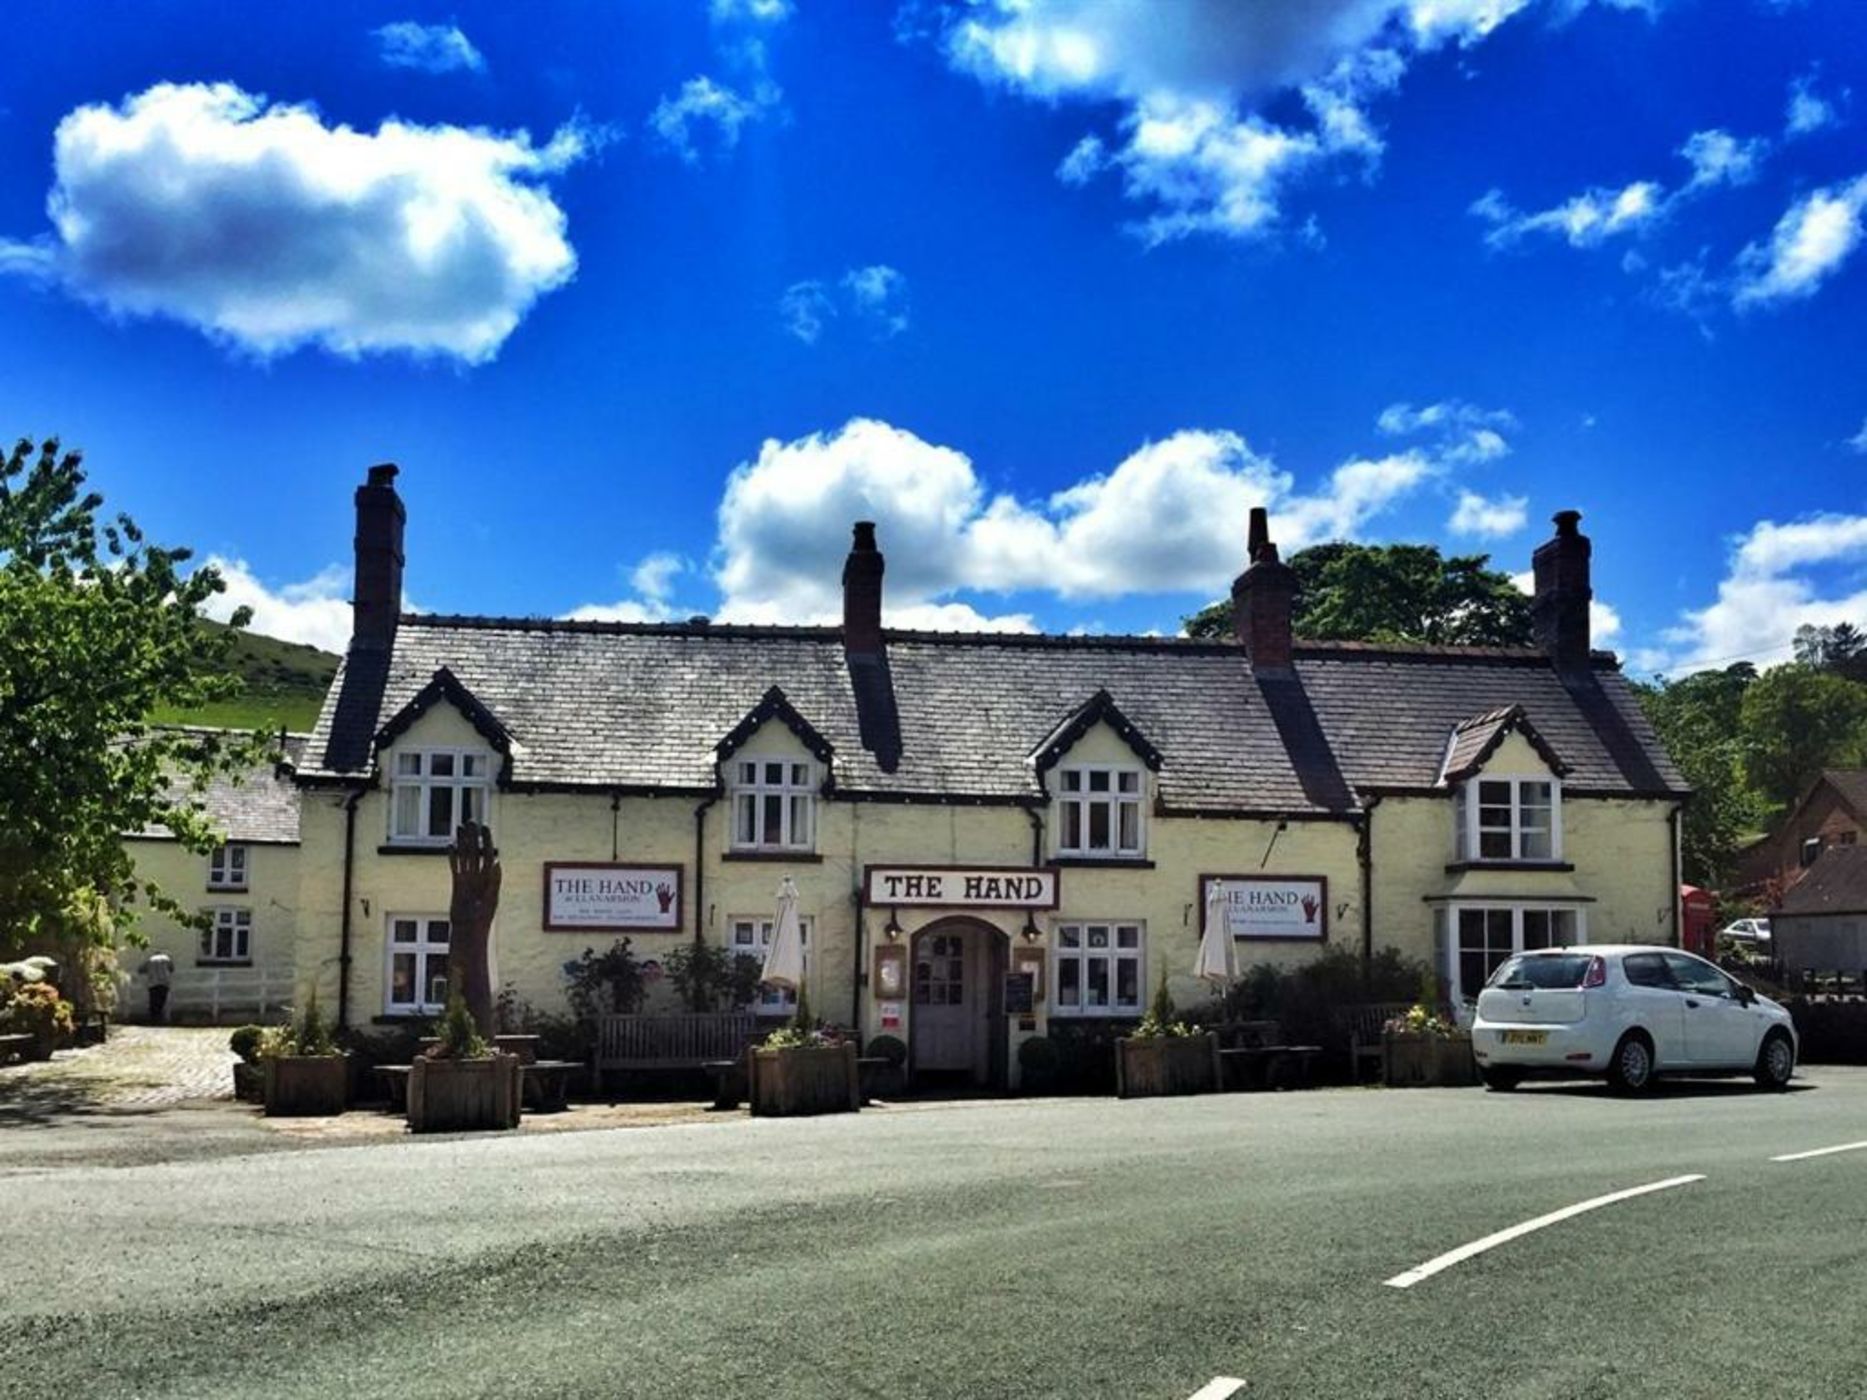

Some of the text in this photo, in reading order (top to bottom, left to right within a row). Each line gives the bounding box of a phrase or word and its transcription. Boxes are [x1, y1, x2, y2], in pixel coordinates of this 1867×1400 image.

[555, 878, 654, 895] THE HAND
[884, 875, 1043, 900] THE HAND
[1250, 890, 1299, 905] HAND
